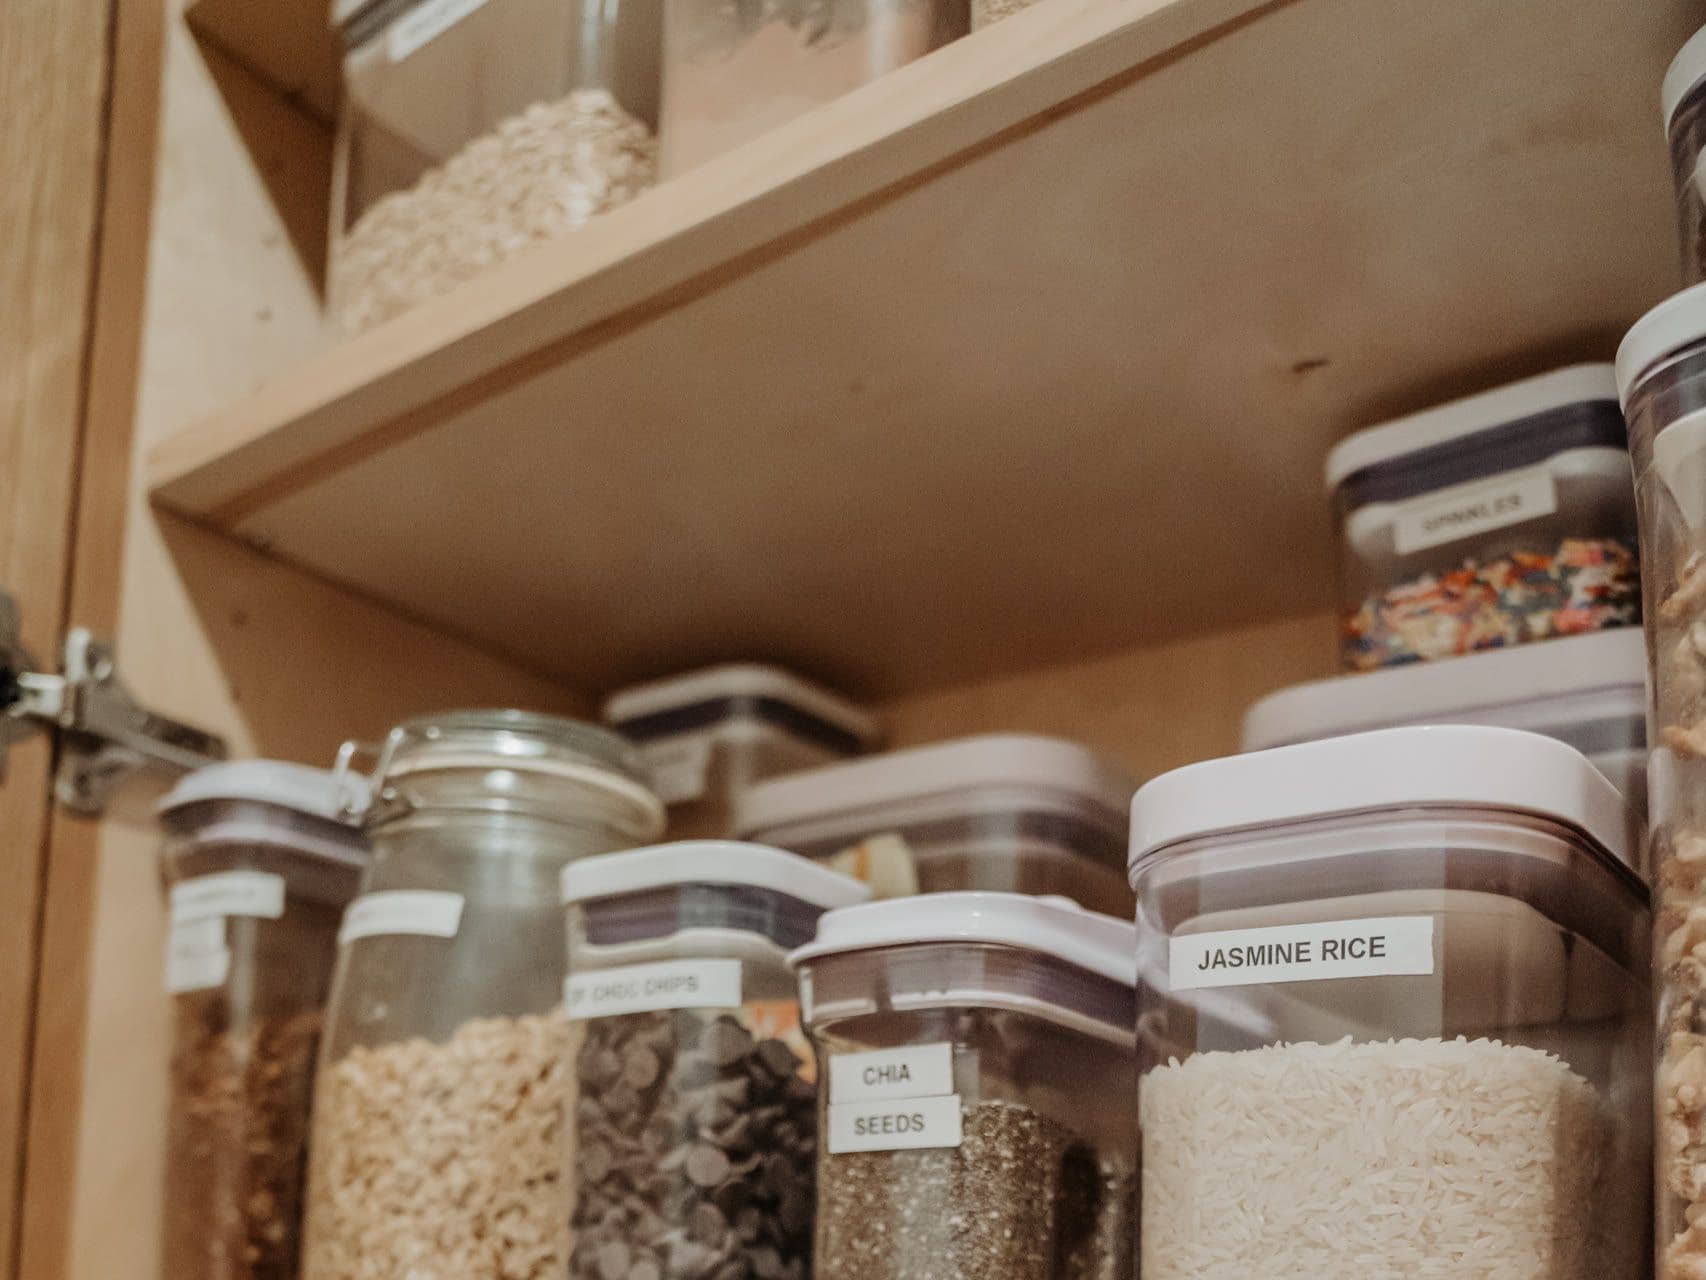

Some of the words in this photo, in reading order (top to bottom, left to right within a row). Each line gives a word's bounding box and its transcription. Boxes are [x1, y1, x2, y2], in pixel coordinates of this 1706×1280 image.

[1197, 941, 1312, 971] JASMINE
[1321, 935, 1387, 961] RICE
[591, 982, 641, 1002] CHOC
[643, 975, 700, 997] CHIPS
[863, 1063, 912, 1086] CHIA
[854, 1113, 926, 1136] SEEDS
